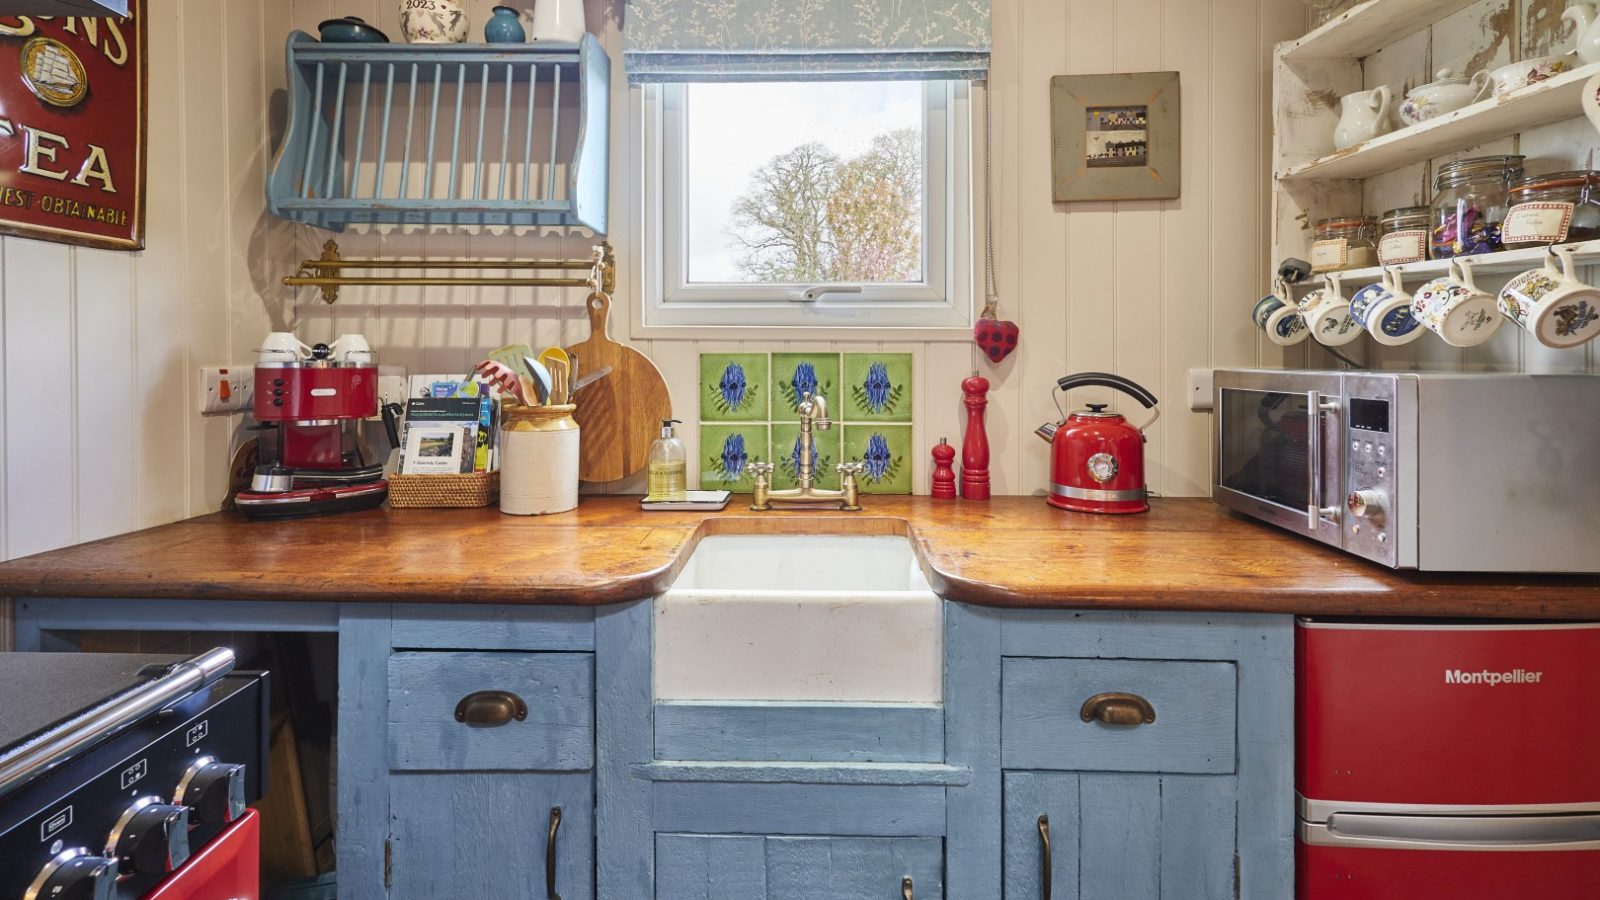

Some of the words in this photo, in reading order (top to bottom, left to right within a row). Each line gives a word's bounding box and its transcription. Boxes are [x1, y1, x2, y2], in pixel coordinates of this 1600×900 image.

[406, 0, 436, 10] 2023
[0, 119, 117, 193] EA
[41, 195, 128, 226] OBTAINABLE
[1445, 669, 1543, 687] Montpellier
